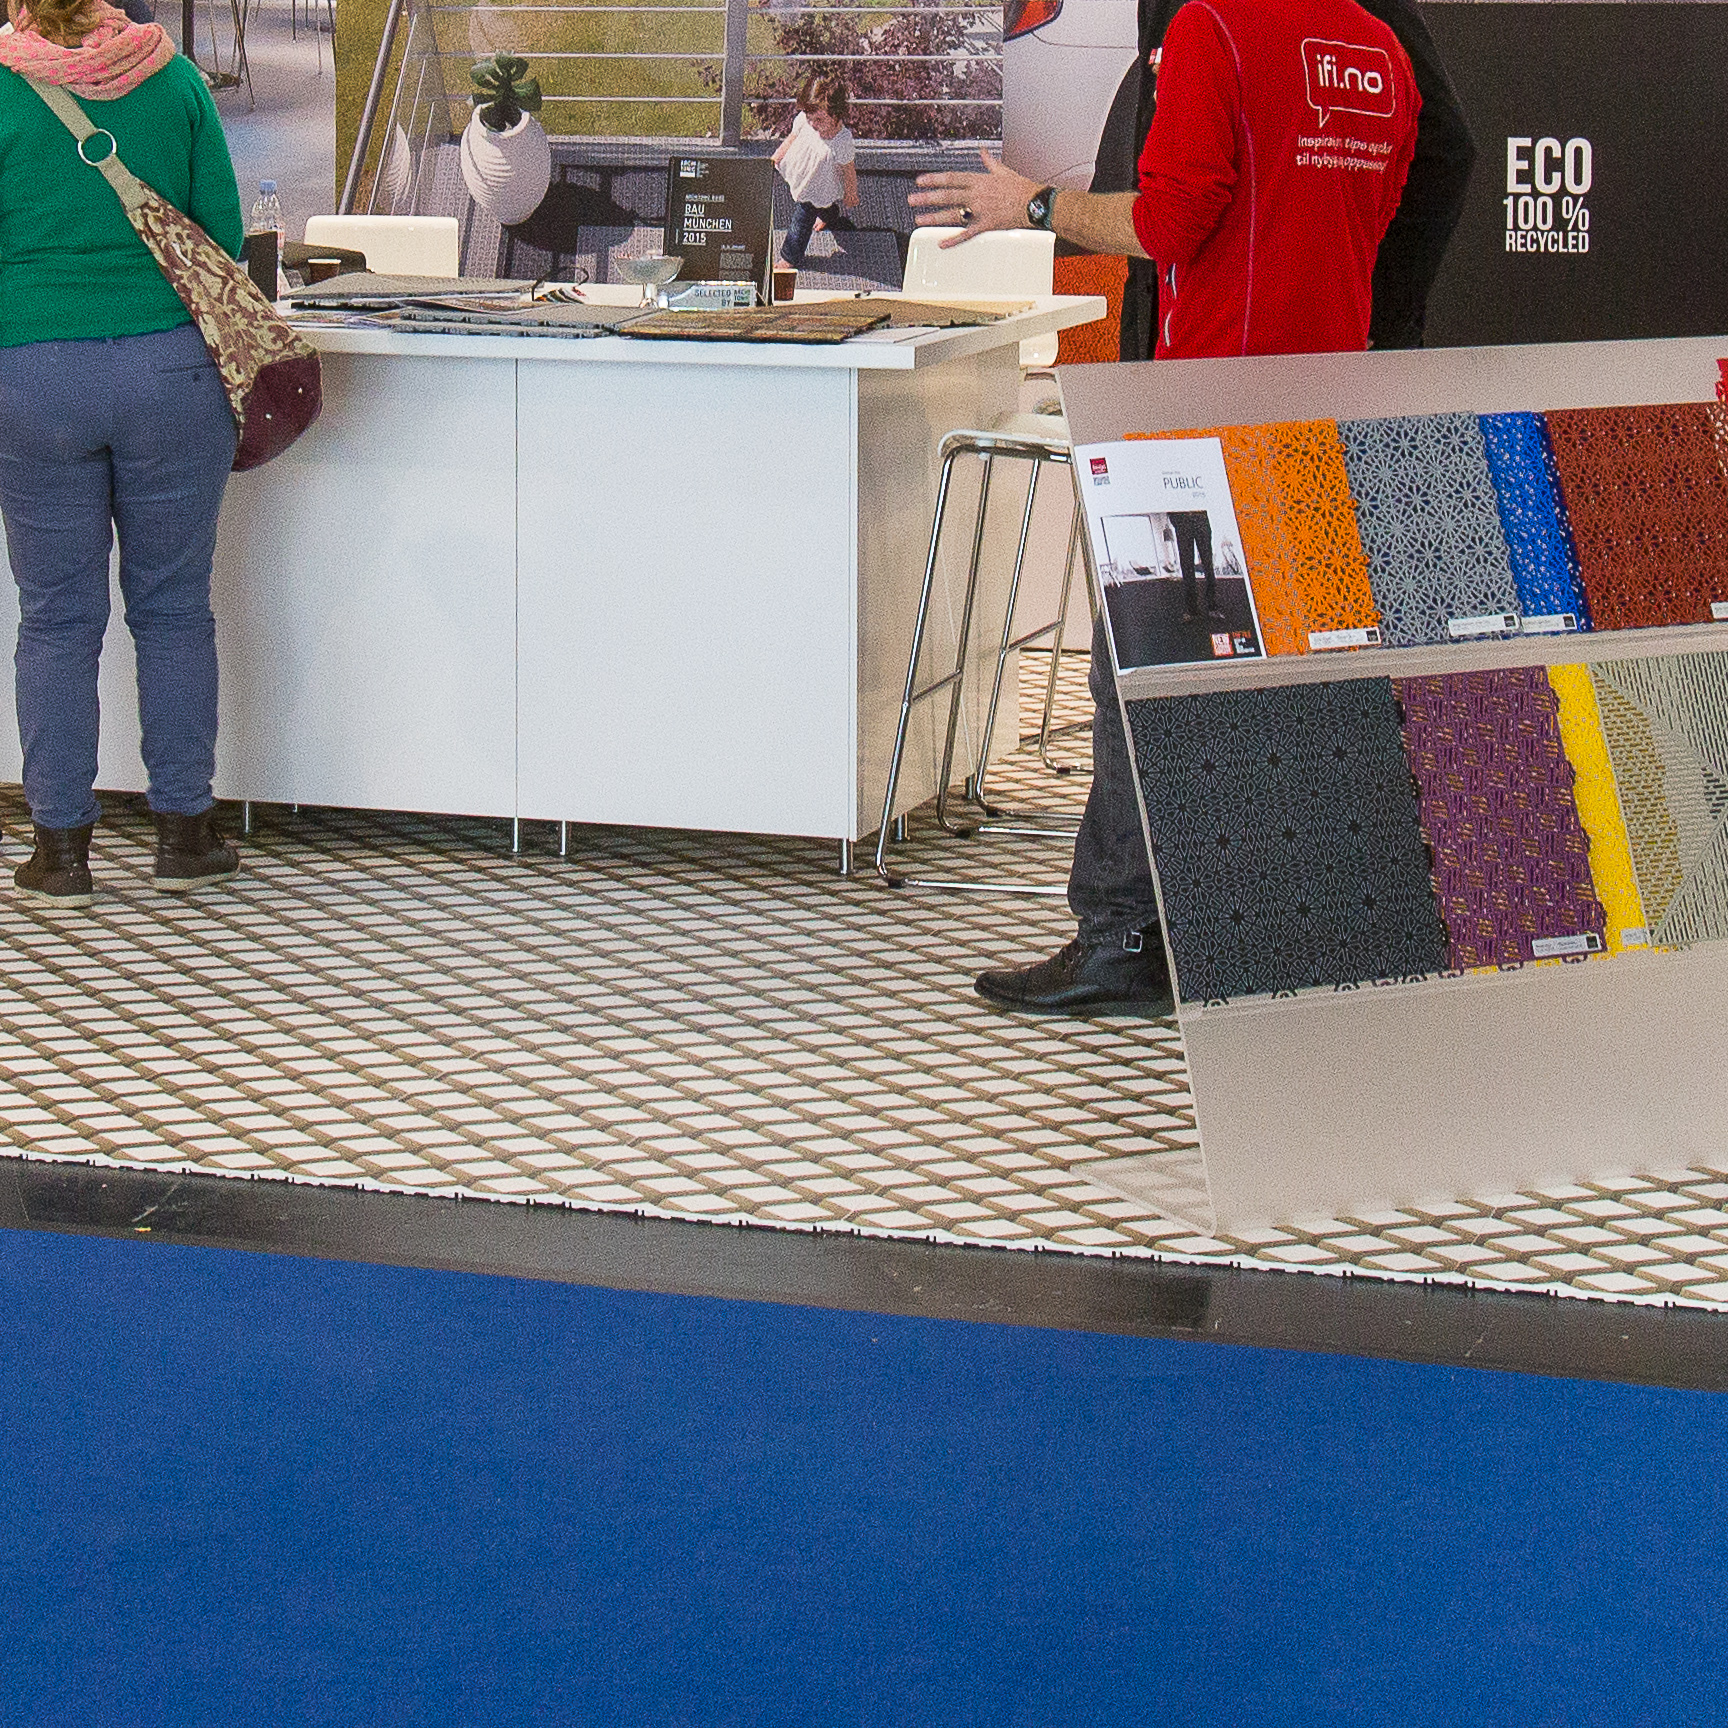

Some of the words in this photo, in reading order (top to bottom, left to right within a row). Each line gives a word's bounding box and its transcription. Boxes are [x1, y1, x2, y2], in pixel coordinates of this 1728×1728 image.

[1316, 54, 1384, 94] ifi.no
[1507, 137, 1593, 194] ECO
[685, 204, 705, 215] BAU
[1503, 196, 1553, 230] 100
[1562, 196, 1590, 231] %
[684, 216, 732, 229] MÜNCHEN
[683, 232, 706, 243] 2015
[1505, 230, 1590, 253] RECYCLED
[1163, 476, 1203, 489] PUBLIC
